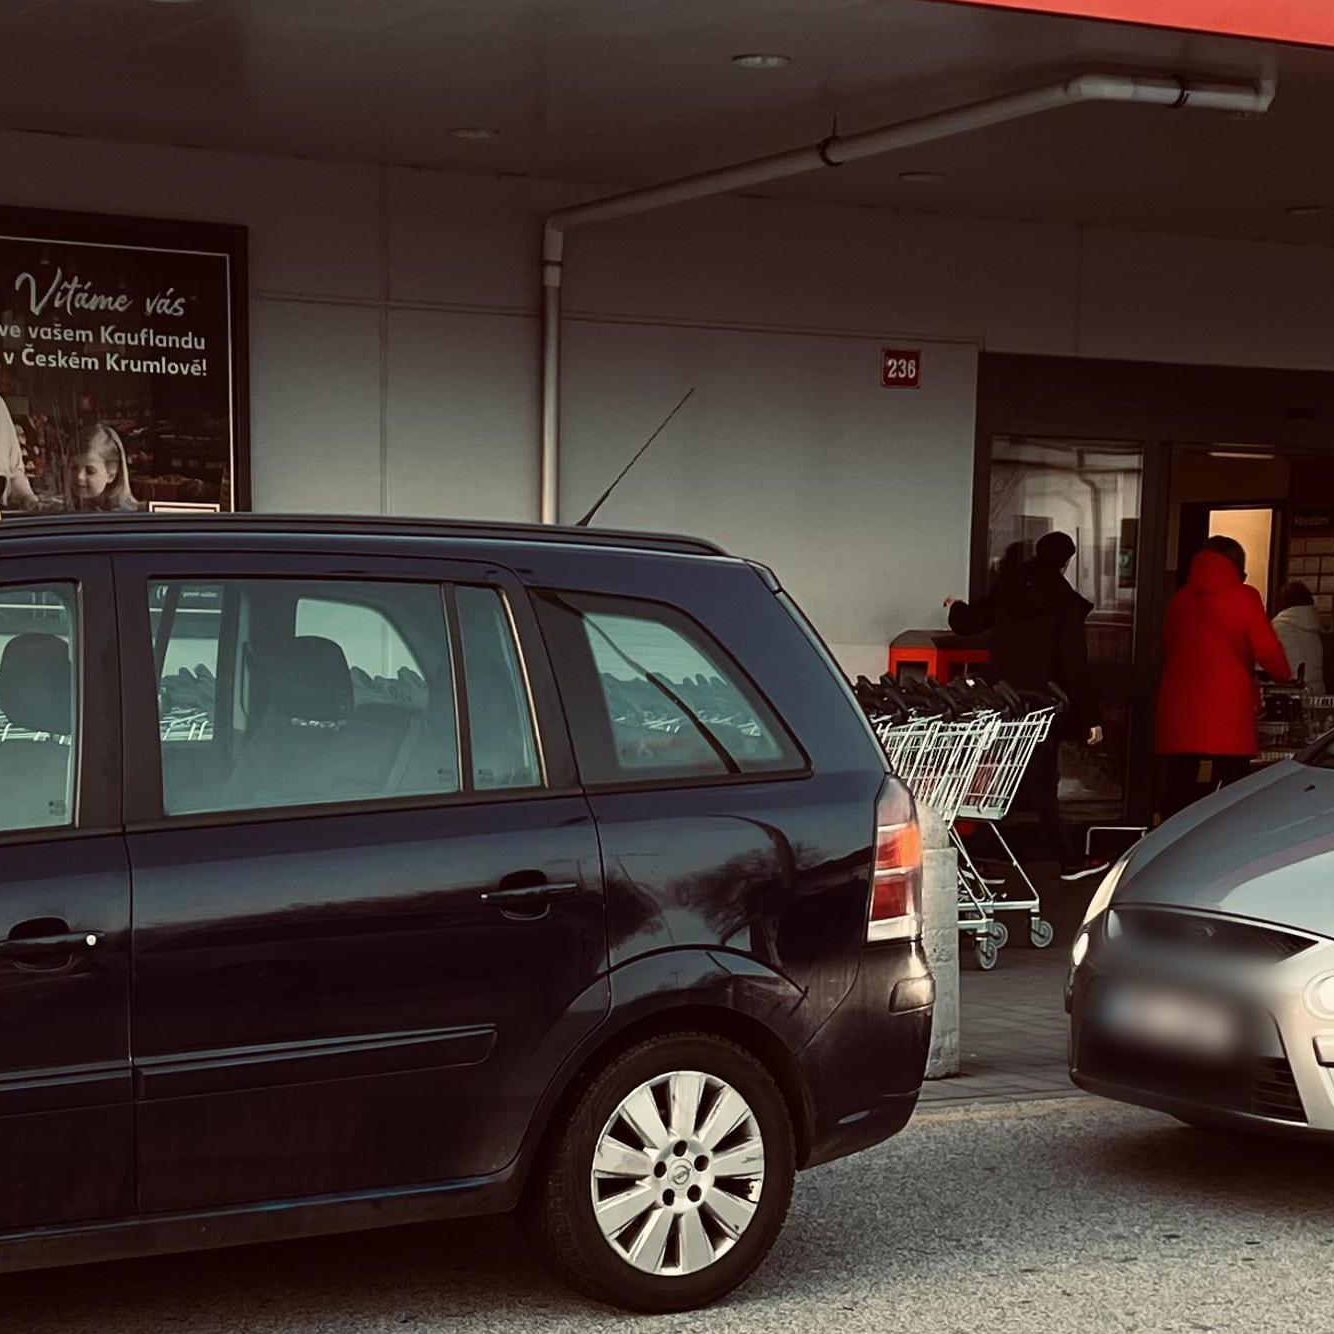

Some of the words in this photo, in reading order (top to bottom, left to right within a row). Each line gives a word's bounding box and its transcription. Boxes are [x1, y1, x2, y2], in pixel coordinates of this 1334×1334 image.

[15, 267, 133, 316] Vítáme
[145, 287, 185, 316] vás
[28, 323, 93, 343] vašem
[100, 325, 206, 350] Kauflandu
[3, 352, 14, 365] v
[21, 344, 99, 370] Českém
[106, 352, 207, 376] Krumlově!
[887, 358, 916, 379] 236
